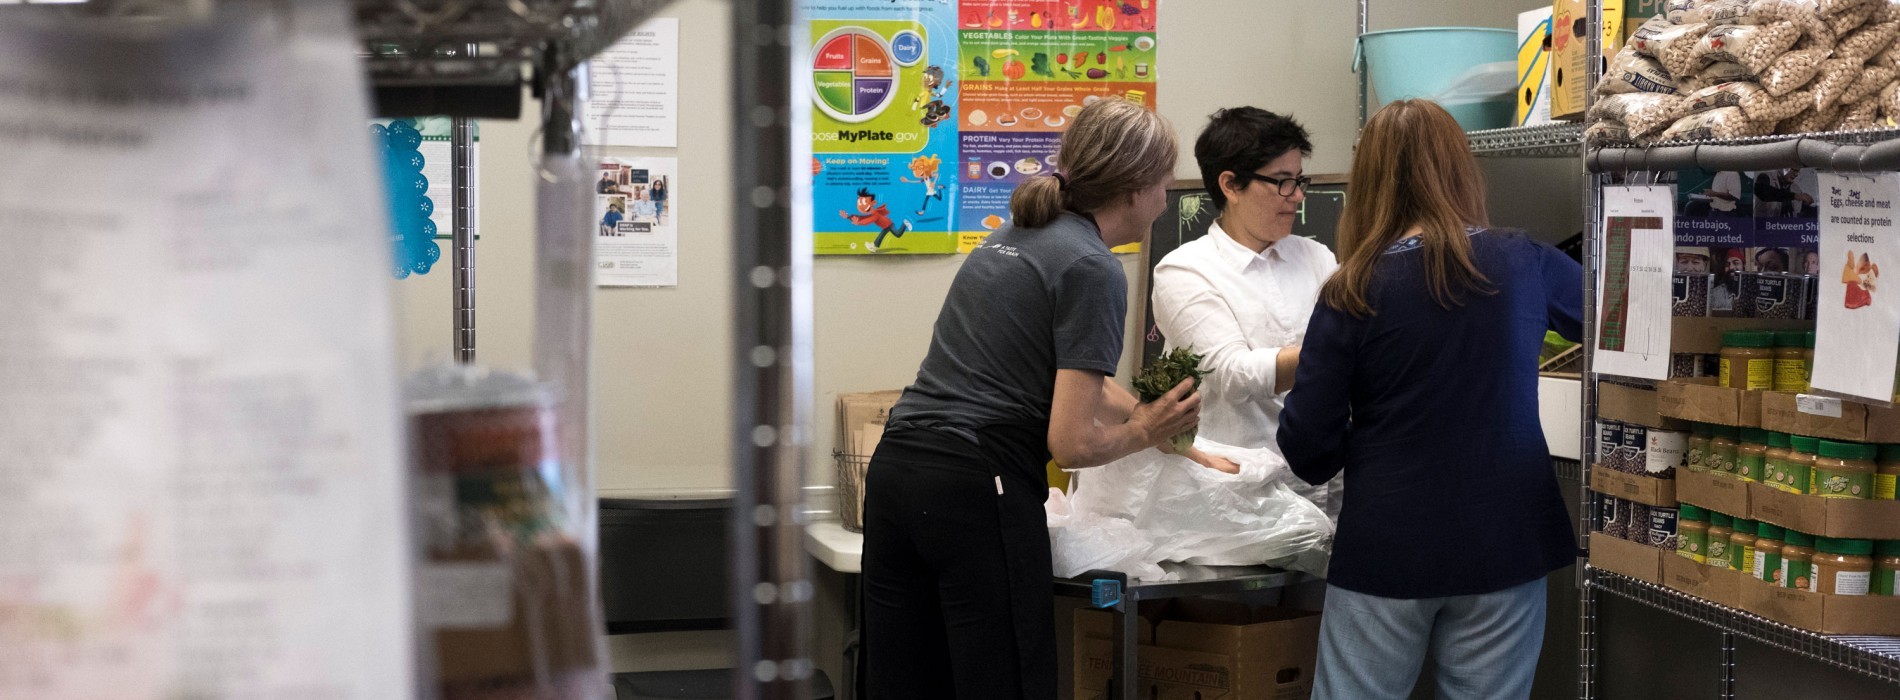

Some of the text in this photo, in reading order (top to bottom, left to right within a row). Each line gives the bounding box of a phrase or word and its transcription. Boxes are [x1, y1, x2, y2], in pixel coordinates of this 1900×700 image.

[962, 32, 1013, 40] VEGETABLES
[898, 44, 916, 53] Dairy
[825, 52, 844, 60] Fruits
[860, 57, 882, 65] Grains
[818, 80, 851, 89] Vegetables
[1634, 76, 1655, 91] RABBIT
[860, 87, 884, 95] Protein
[811, 130, 918, 142] ooseMyPlate.gov
[1830, 196, 1891, 209] Eggs, cheese and meat
[1692, 220, 1731, 232] trabajos,
[1765, 221, 1819, 231] Between Shi
[1841, 215, 1863, 225] counted
[1871, 217, 1892, 227] protein
[1696, 235, 1715, 244] para
[1717, 234, 1744, 243] usted.
[1801, 235, 1819, 243] SNA
[1847, 232, 1874, 243] selections
[1155, 666, 1218, 685] MOUNTAIN
